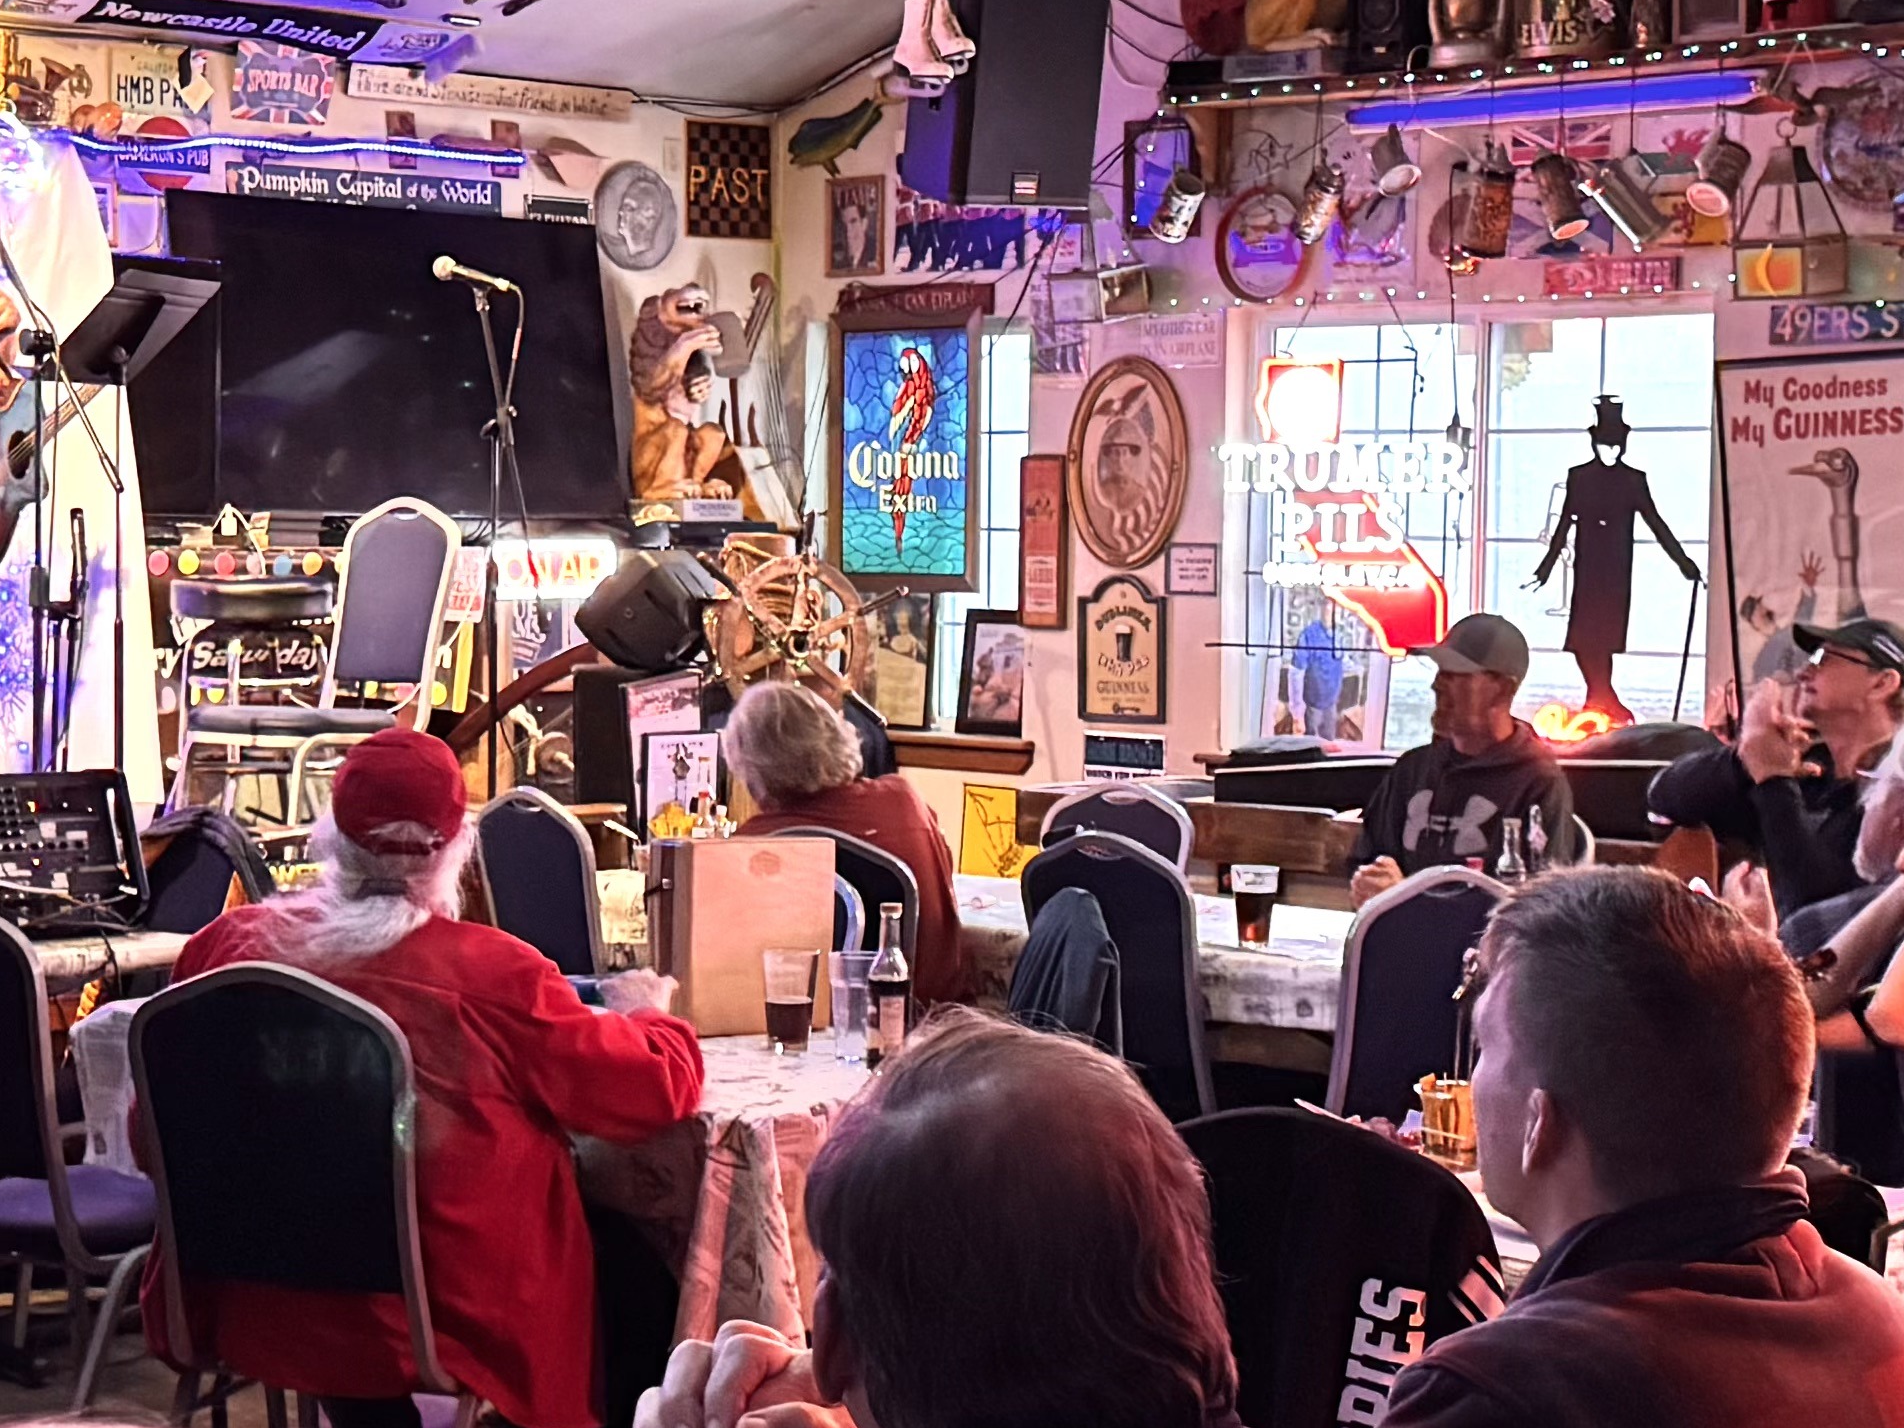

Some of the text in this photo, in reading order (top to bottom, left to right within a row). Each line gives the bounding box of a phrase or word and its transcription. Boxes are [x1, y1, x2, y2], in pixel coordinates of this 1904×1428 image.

[99, 0, 363, 52] Newcastle United
[1521, 20, 1577, 46] ELVIS
[116, 73, 154, 105] HMB
[247, 69, 319, 97] SPORTS BAR
[186, 148, 211, 167] PUB
[241, 165, 330, 197] Pumpkin
[335, 169, 402, 201] Capital
[406, 184, 420, 200] of
[441, 180, 493, 205] World
[689, 168, 771, 205] PAST
[1772, 305, 1871, 343] 49ERS
[1744, 377, 1889, 408] My Goodness
[1732, 406, 1904, 448] My GUINNESS
[848, 439, 961, 492] Corona
[1216, 442, 1473, 494] TRUMER
[878, 483, 938, 514] Extra
[1279, 502, 1405, 554] PILS
[1096, 680, 1151, 695] GUINNESS
